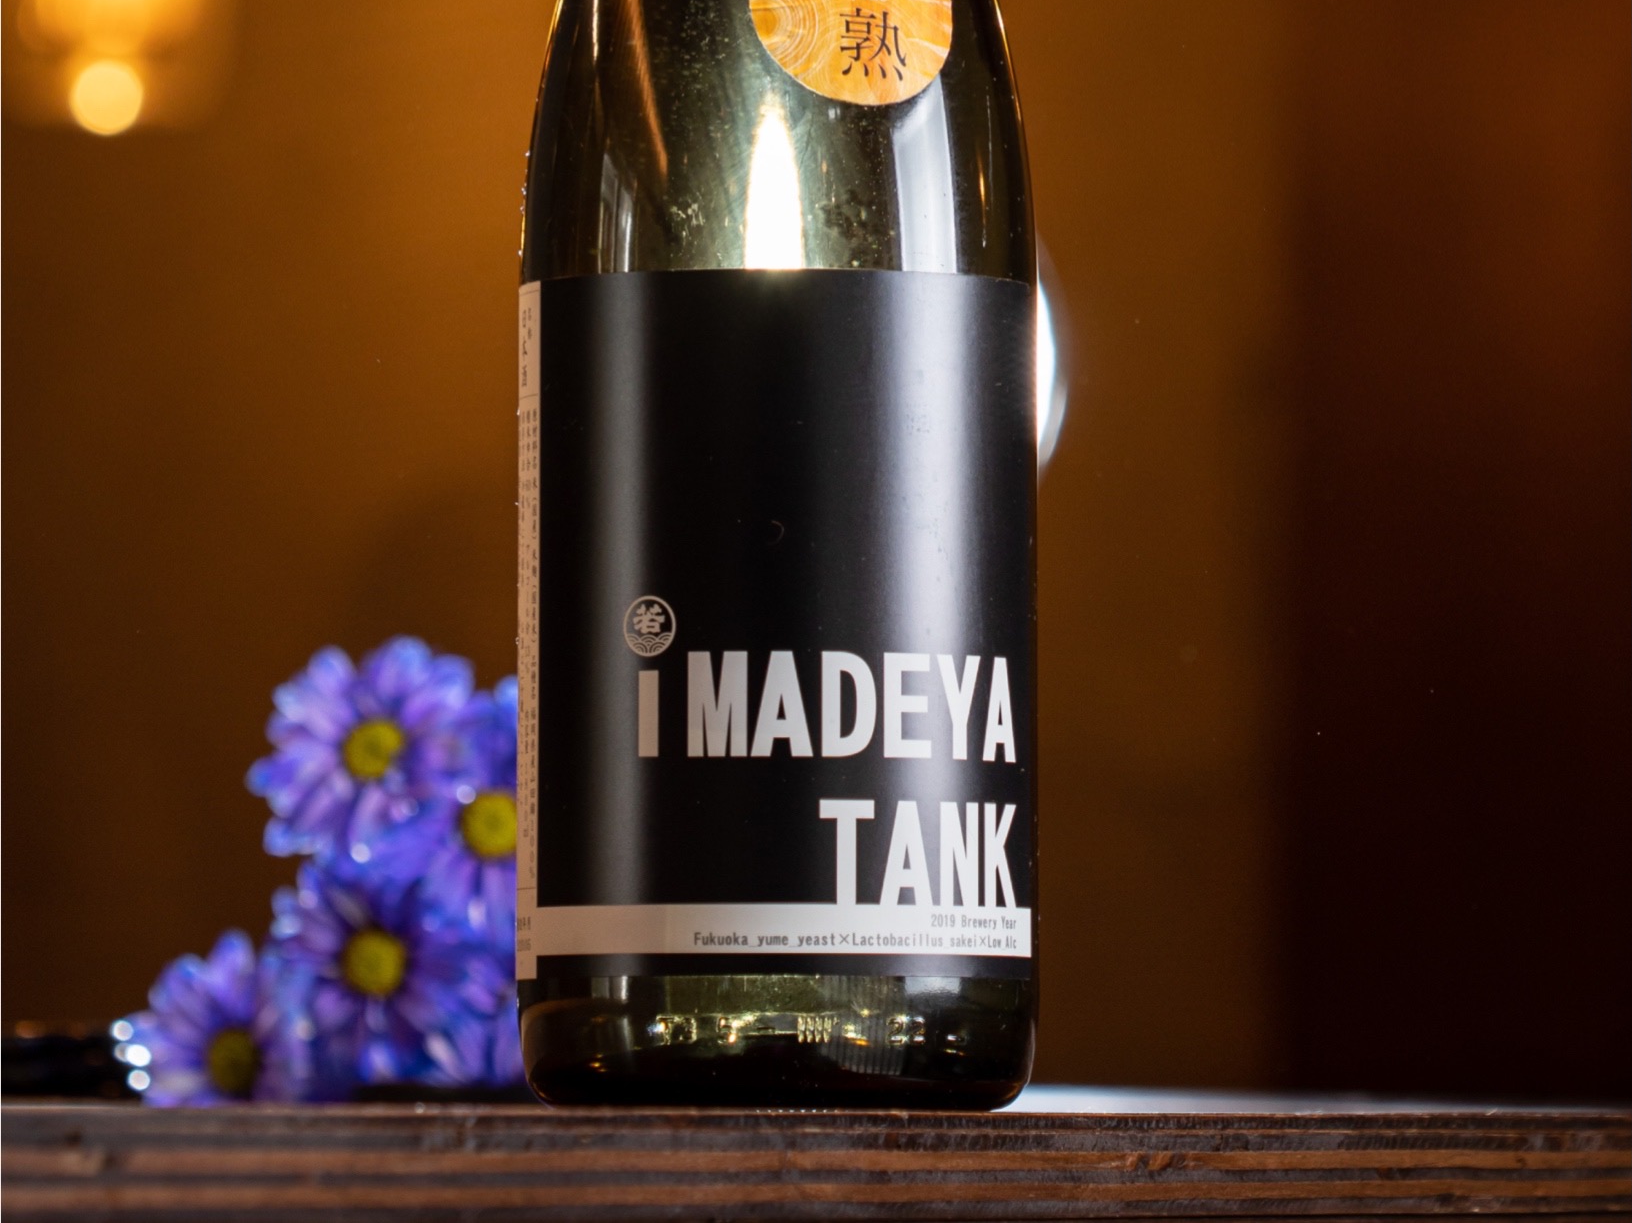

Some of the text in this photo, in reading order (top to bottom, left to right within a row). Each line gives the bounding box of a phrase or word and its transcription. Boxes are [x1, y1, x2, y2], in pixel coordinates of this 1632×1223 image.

[839, 7, 907, 81] 熟
[687, 650, 1016, 763] MADEYA
[819, 799, 1017, 908] TANK
[931, 914, 1017, 930] 2019 Brewery Year
